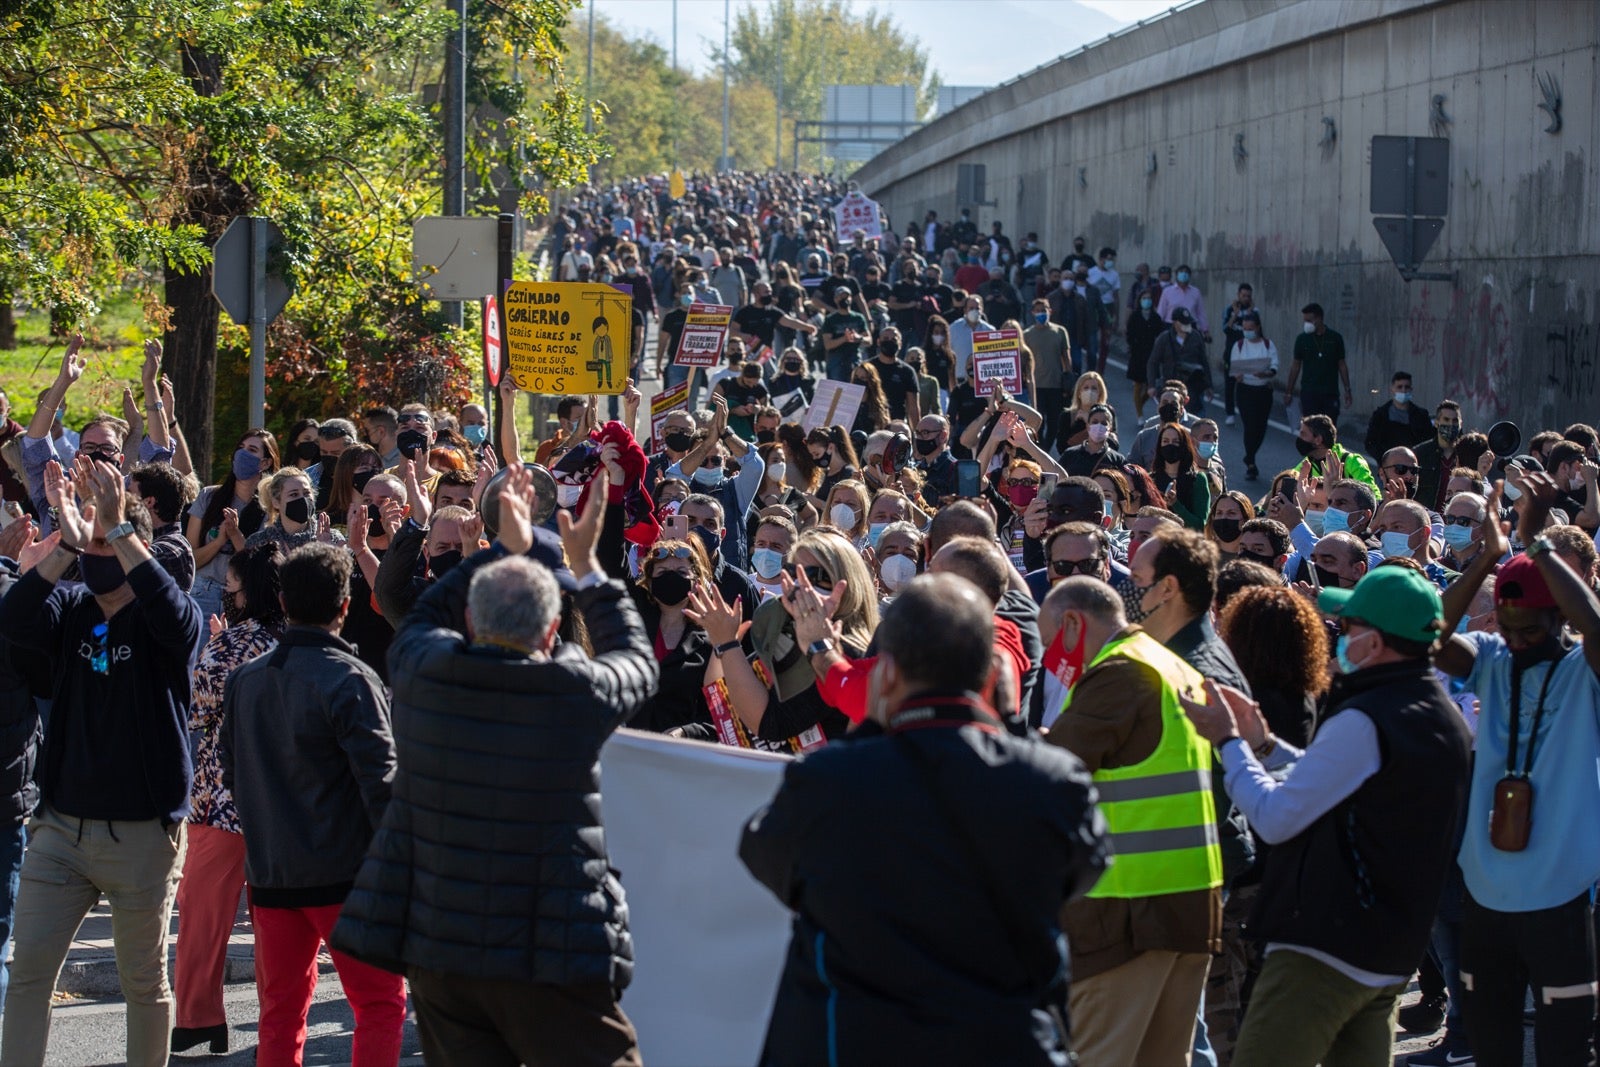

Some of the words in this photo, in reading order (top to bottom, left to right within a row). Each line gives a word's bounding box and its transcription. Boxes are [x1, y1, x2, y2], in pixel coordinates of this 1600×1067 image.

[507, 288, 561, 304] ESTIMADO
[509, 306, 570, 325] GOBIERNO
[535, 329, 565, 341] LIBRES
[570, 332, 582, 342] DE
[510, 340, 542, 353] VUESTROS
[546, 343, 579, 356] ACTOS,
[686, 341, 717, 349] TRABAJAR!
[977, 341, 1015, 350] MANIFESTACIÓN
[511, 353, 526, 363] PERO
[526, 354, 536, 364] NO
[538, 355, 547, 364] DE
[549, 356, 567, 365] SUS
[981, 362, 1013, 370] ¡QUEREMOS
[981, 369, 1015, 377] TRABAJAR!
